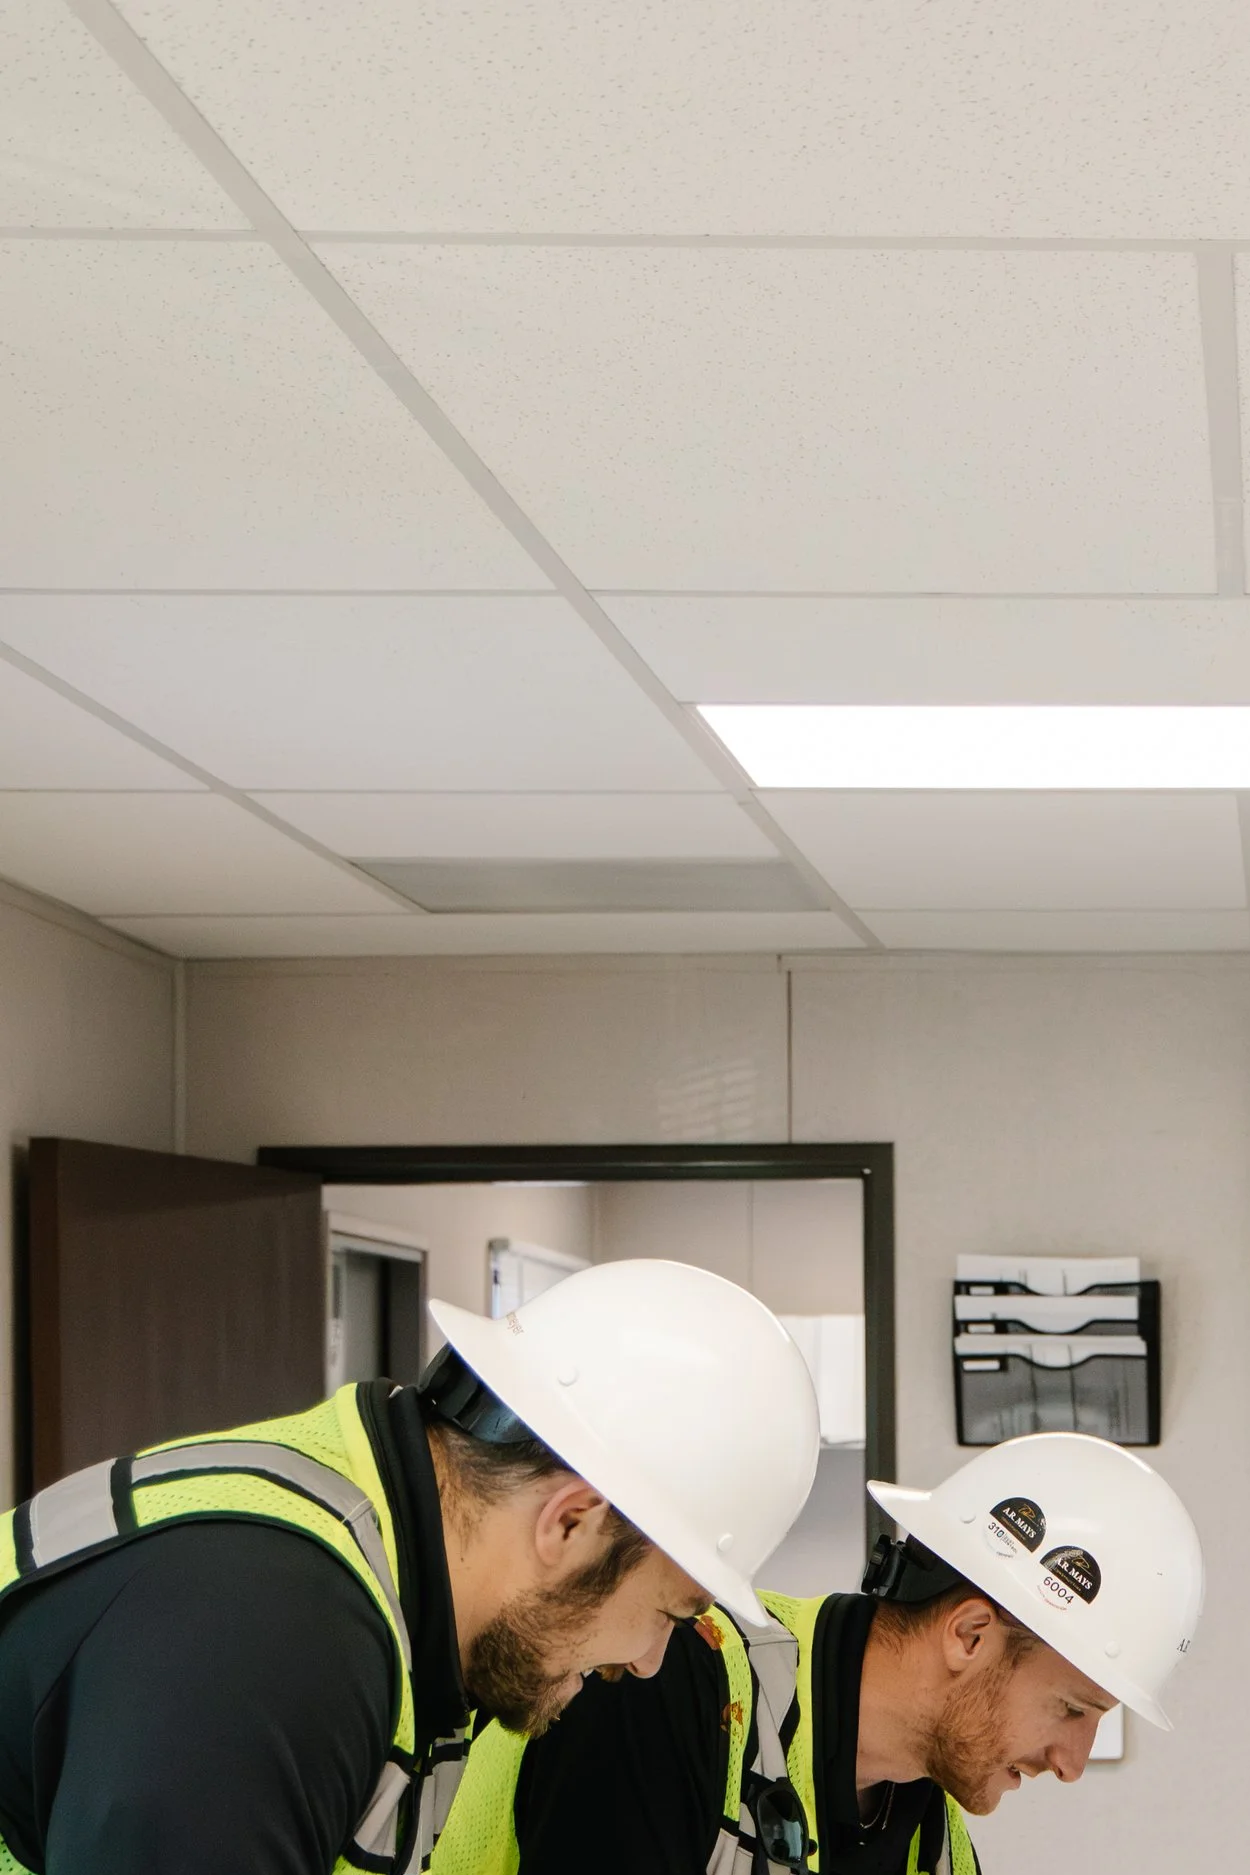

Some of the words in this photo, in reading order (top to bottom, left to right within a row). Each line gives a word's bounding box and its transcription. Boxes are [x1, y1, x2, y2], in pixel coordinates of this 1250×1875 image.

[987, 1521, 1005, 1539] 310
[1015, 1517, 1037, 1539] MAYS
[1068, 1568, 1093, 1590] MAYS
[1043, 1576, 1074, 1605] 6004
